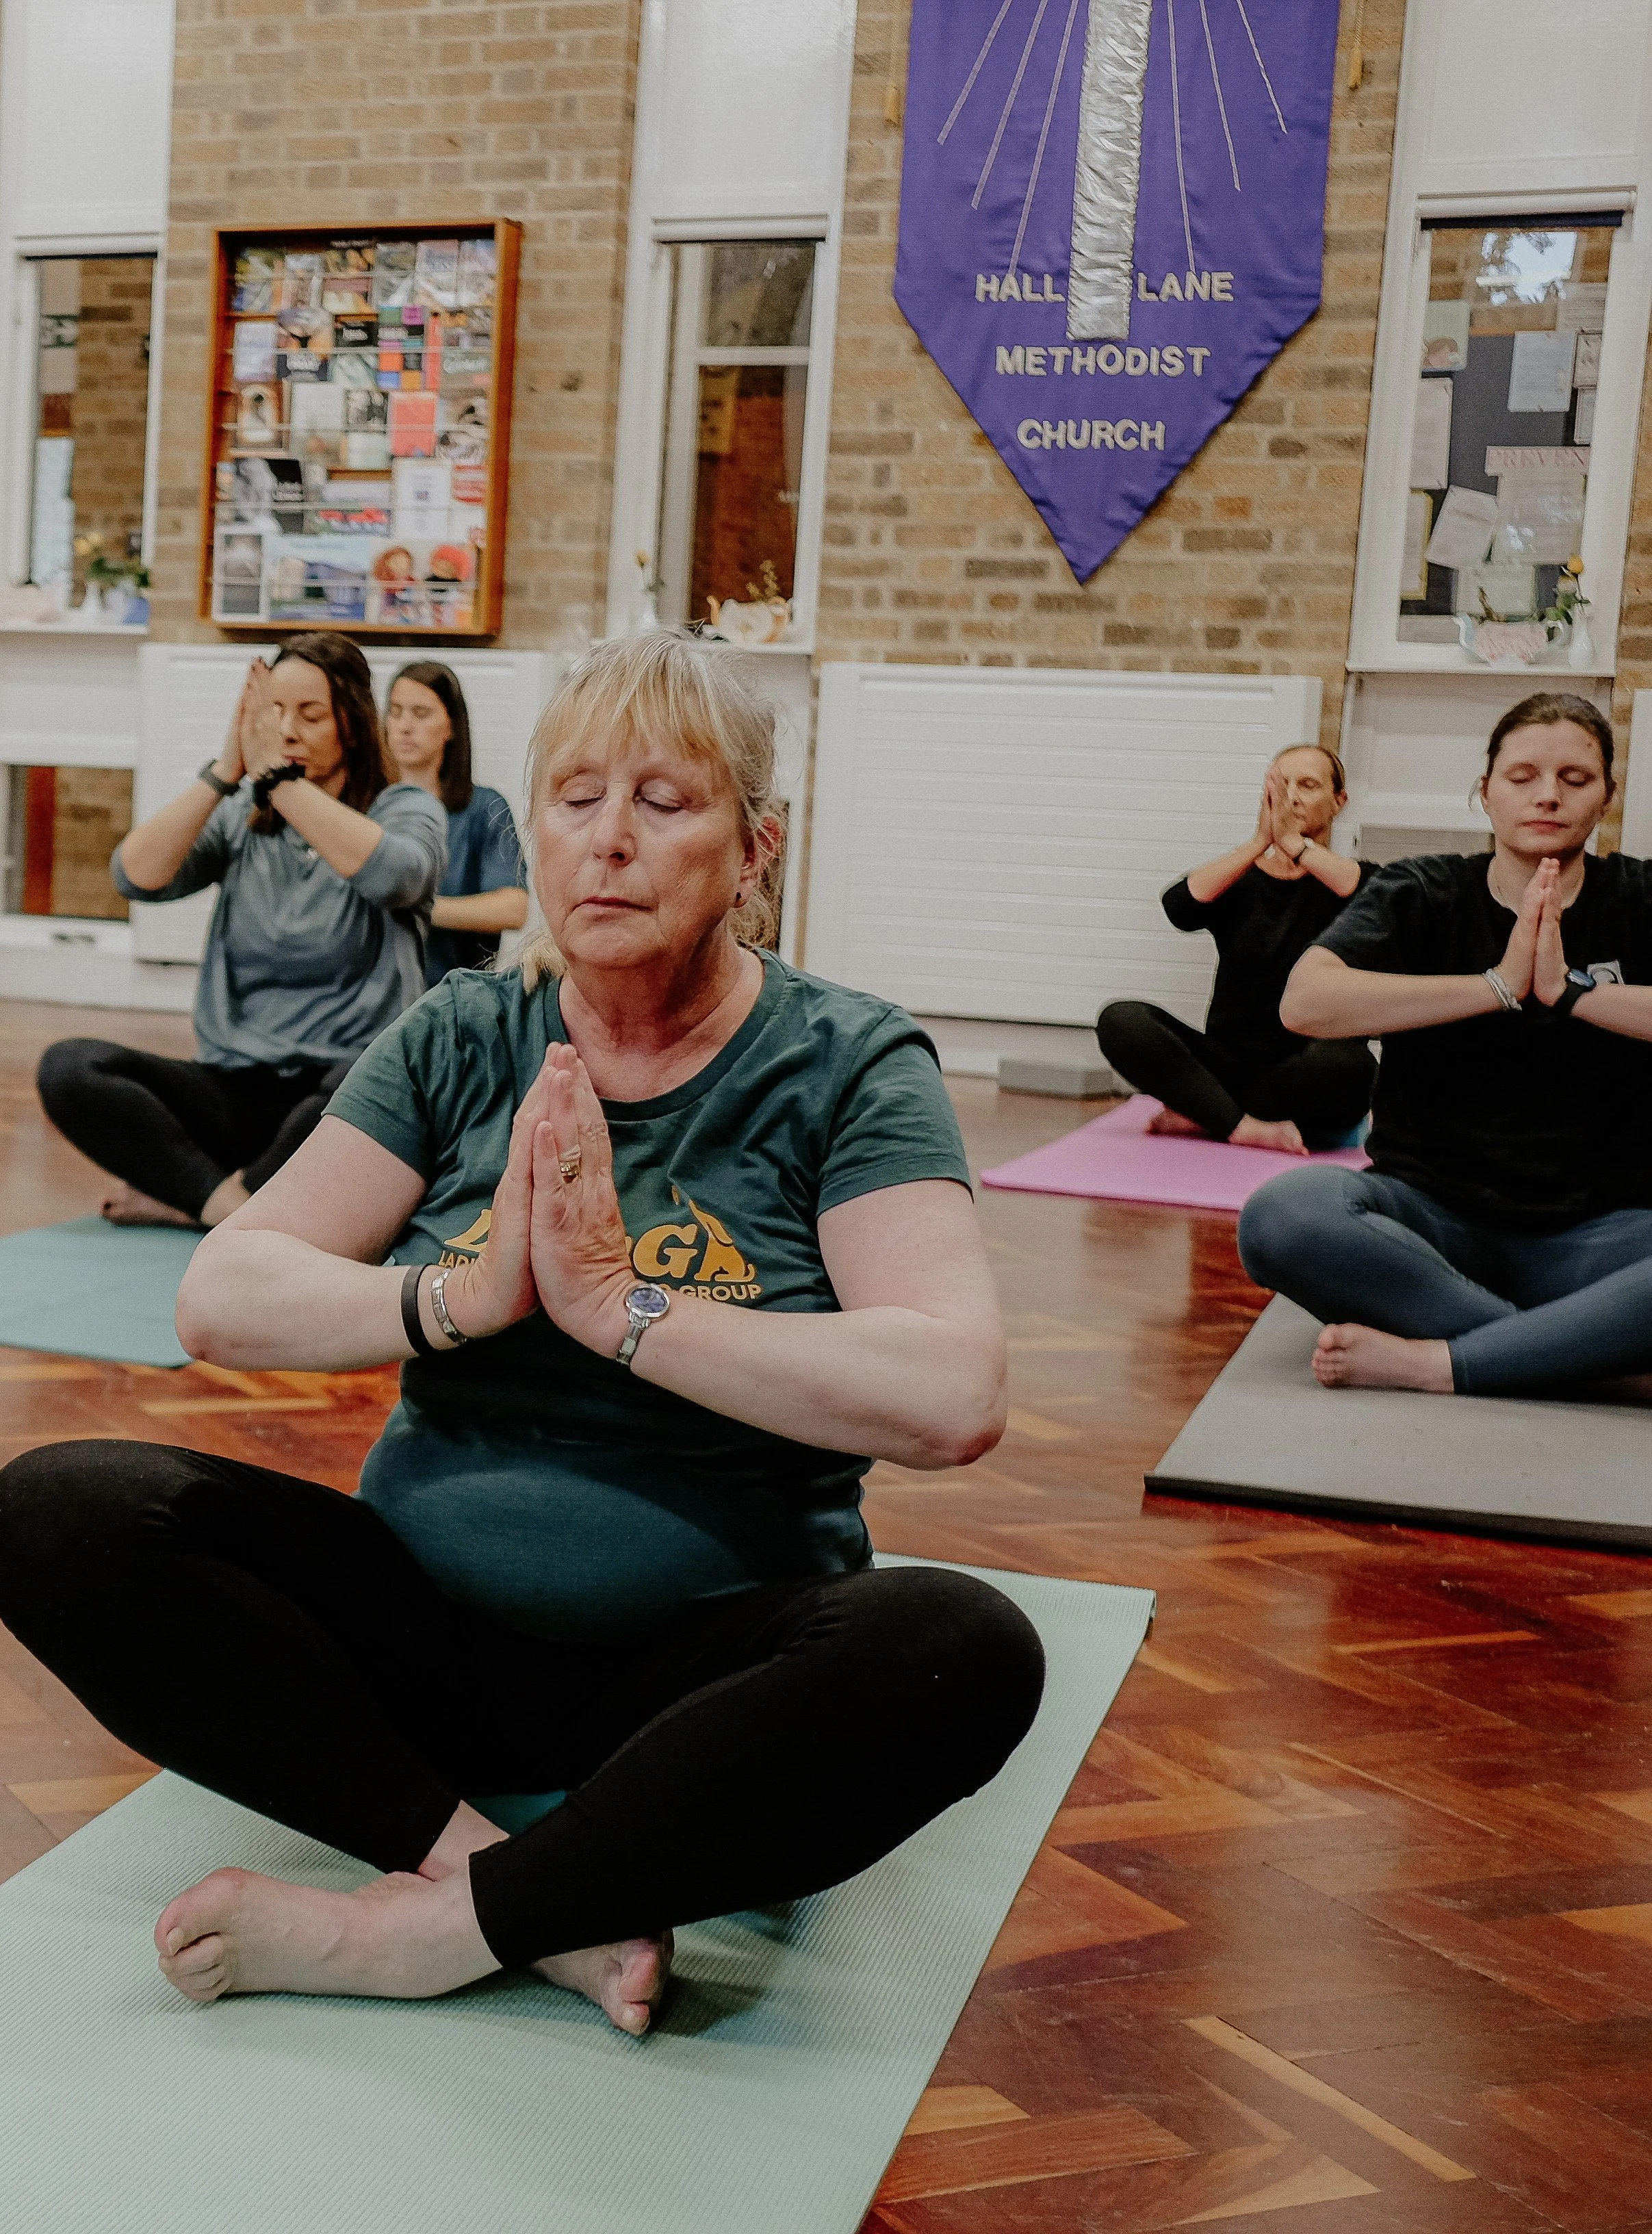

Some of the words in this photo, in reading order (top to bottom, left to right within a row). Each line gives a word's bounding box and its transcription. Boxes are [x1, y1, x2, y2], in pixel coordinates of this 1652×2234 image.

[975, 273, 1066, 302] HALL
[1137, 272, 1234, 302] LANE
[995, 344, 1211, 376] METHODIST
[1016, 418, 1165, 450] CHURCH
[680, 1284, 762, 1301] GROUP
